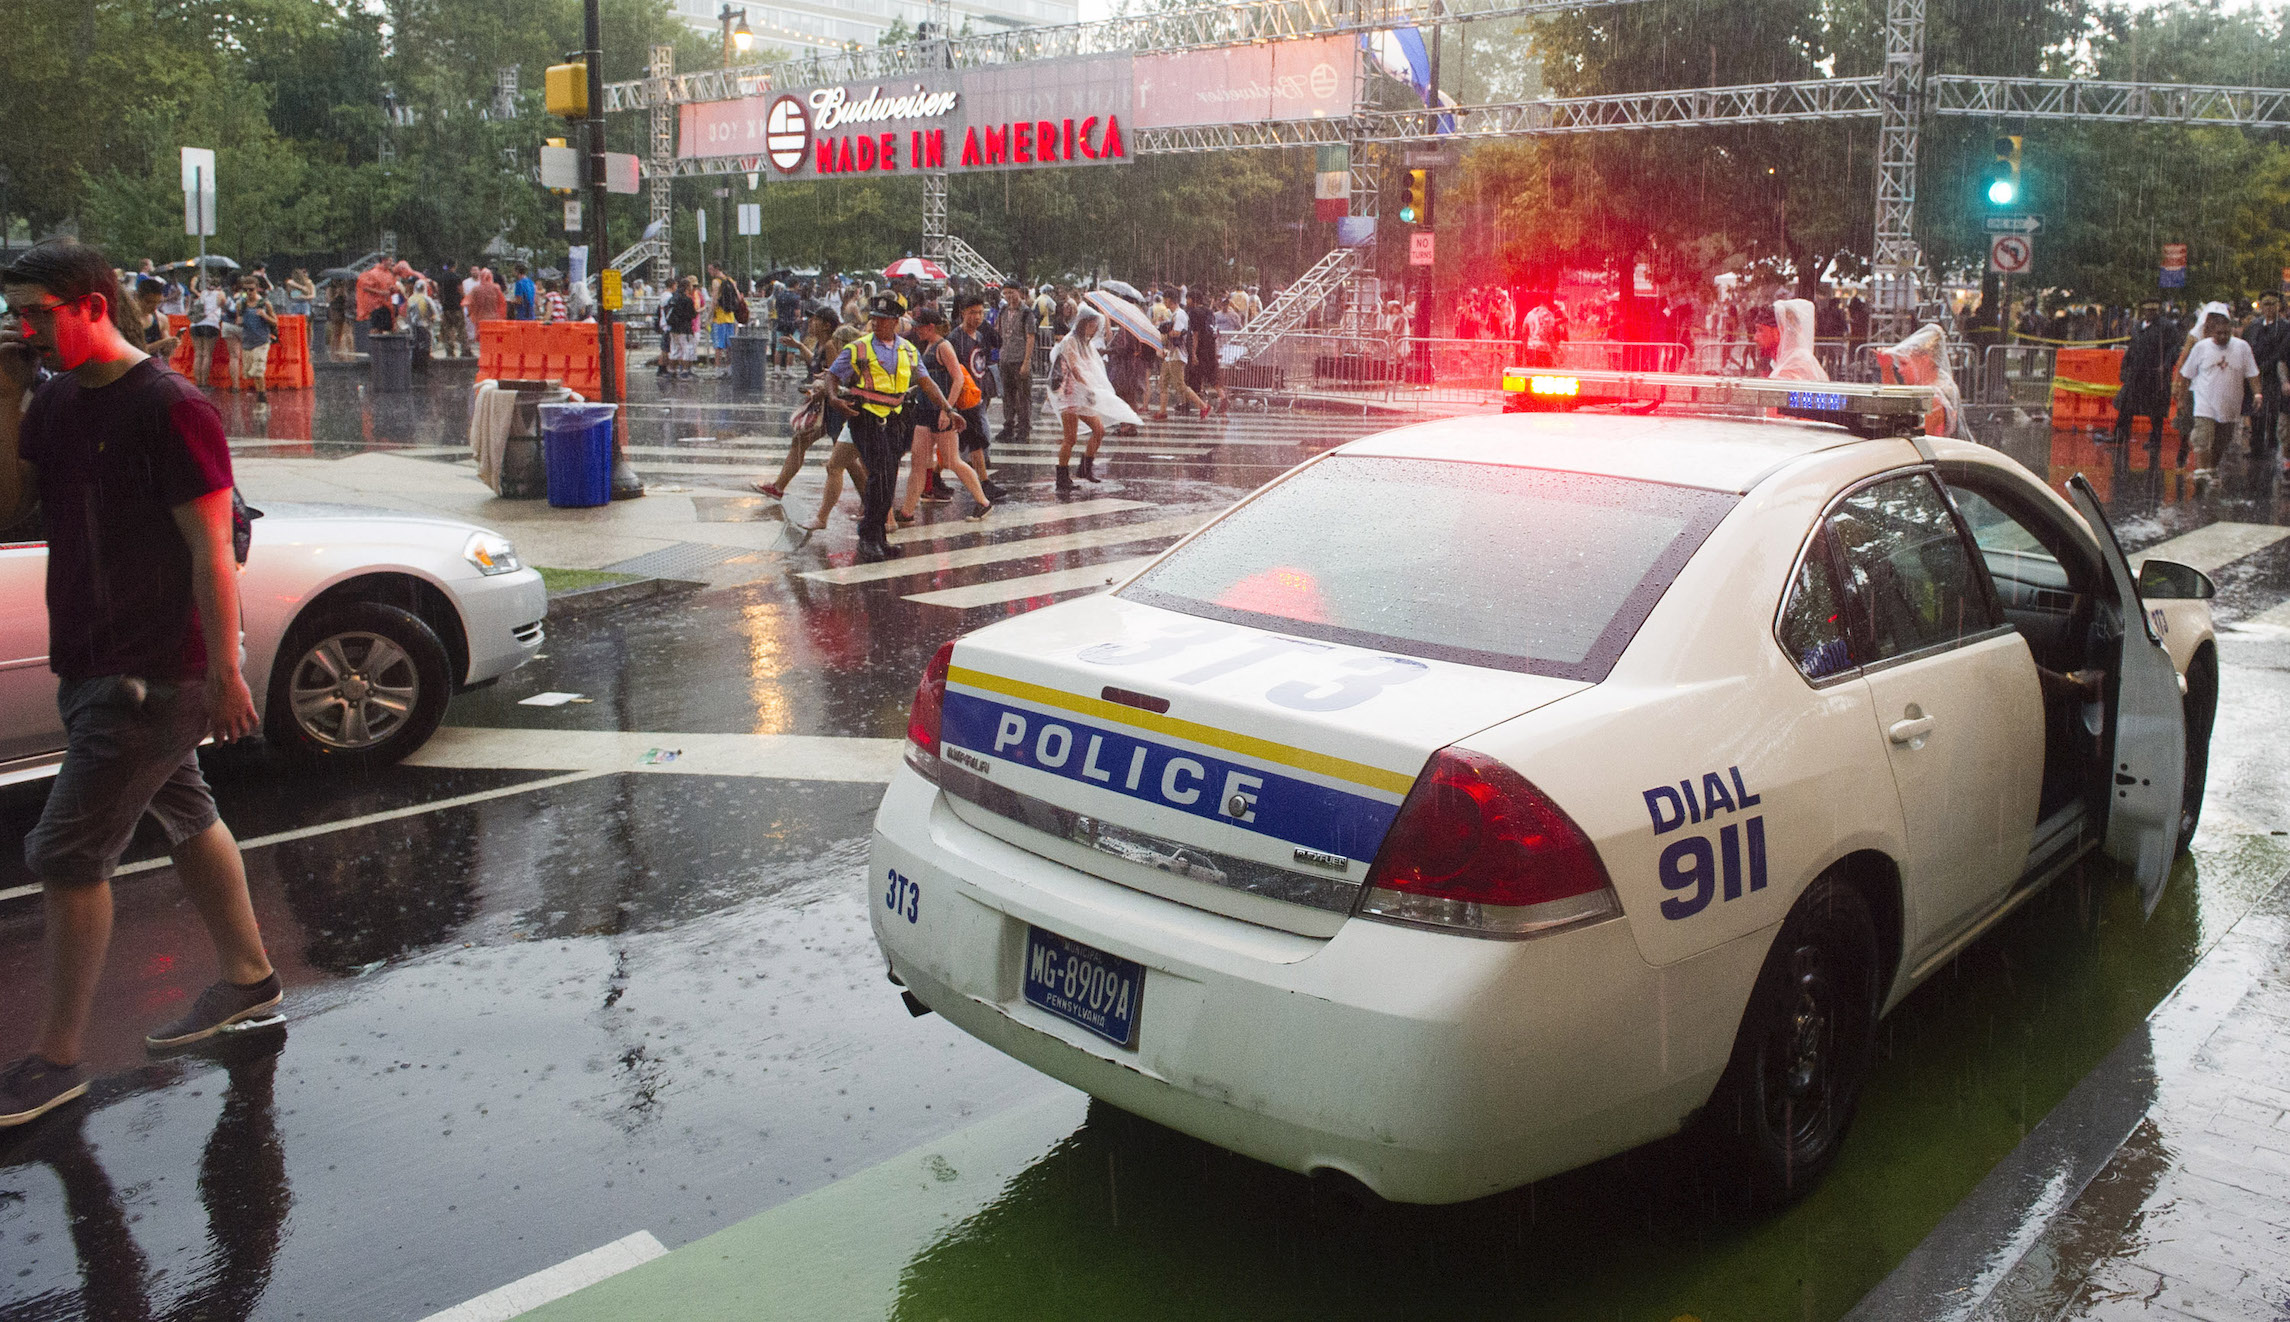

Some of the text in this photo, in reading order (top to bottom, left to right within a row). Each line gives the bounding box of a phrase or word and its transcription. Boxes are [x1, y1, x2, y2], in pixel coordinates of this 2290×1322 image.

[808, 84, 958, 130] Budweiser
[815, 114, 1125, 174] MADE IN AMERICA
[1411, 250, 1432, 260] TURNS
[1416, 238, 1429, 249] NO
[1077, 622, 1431, 712] 3T3
[994, 711, 1264, 824] POLICE
[1642, 765, 1761, 836] DIAL
[885, 868, 920, 924] 3T3
[1658, 815, 1768, 921] 911
[1030, 943, 1130, 1021] MG-8909A
[1046, 992, 1106, 1028] PENNSYLVANIA
